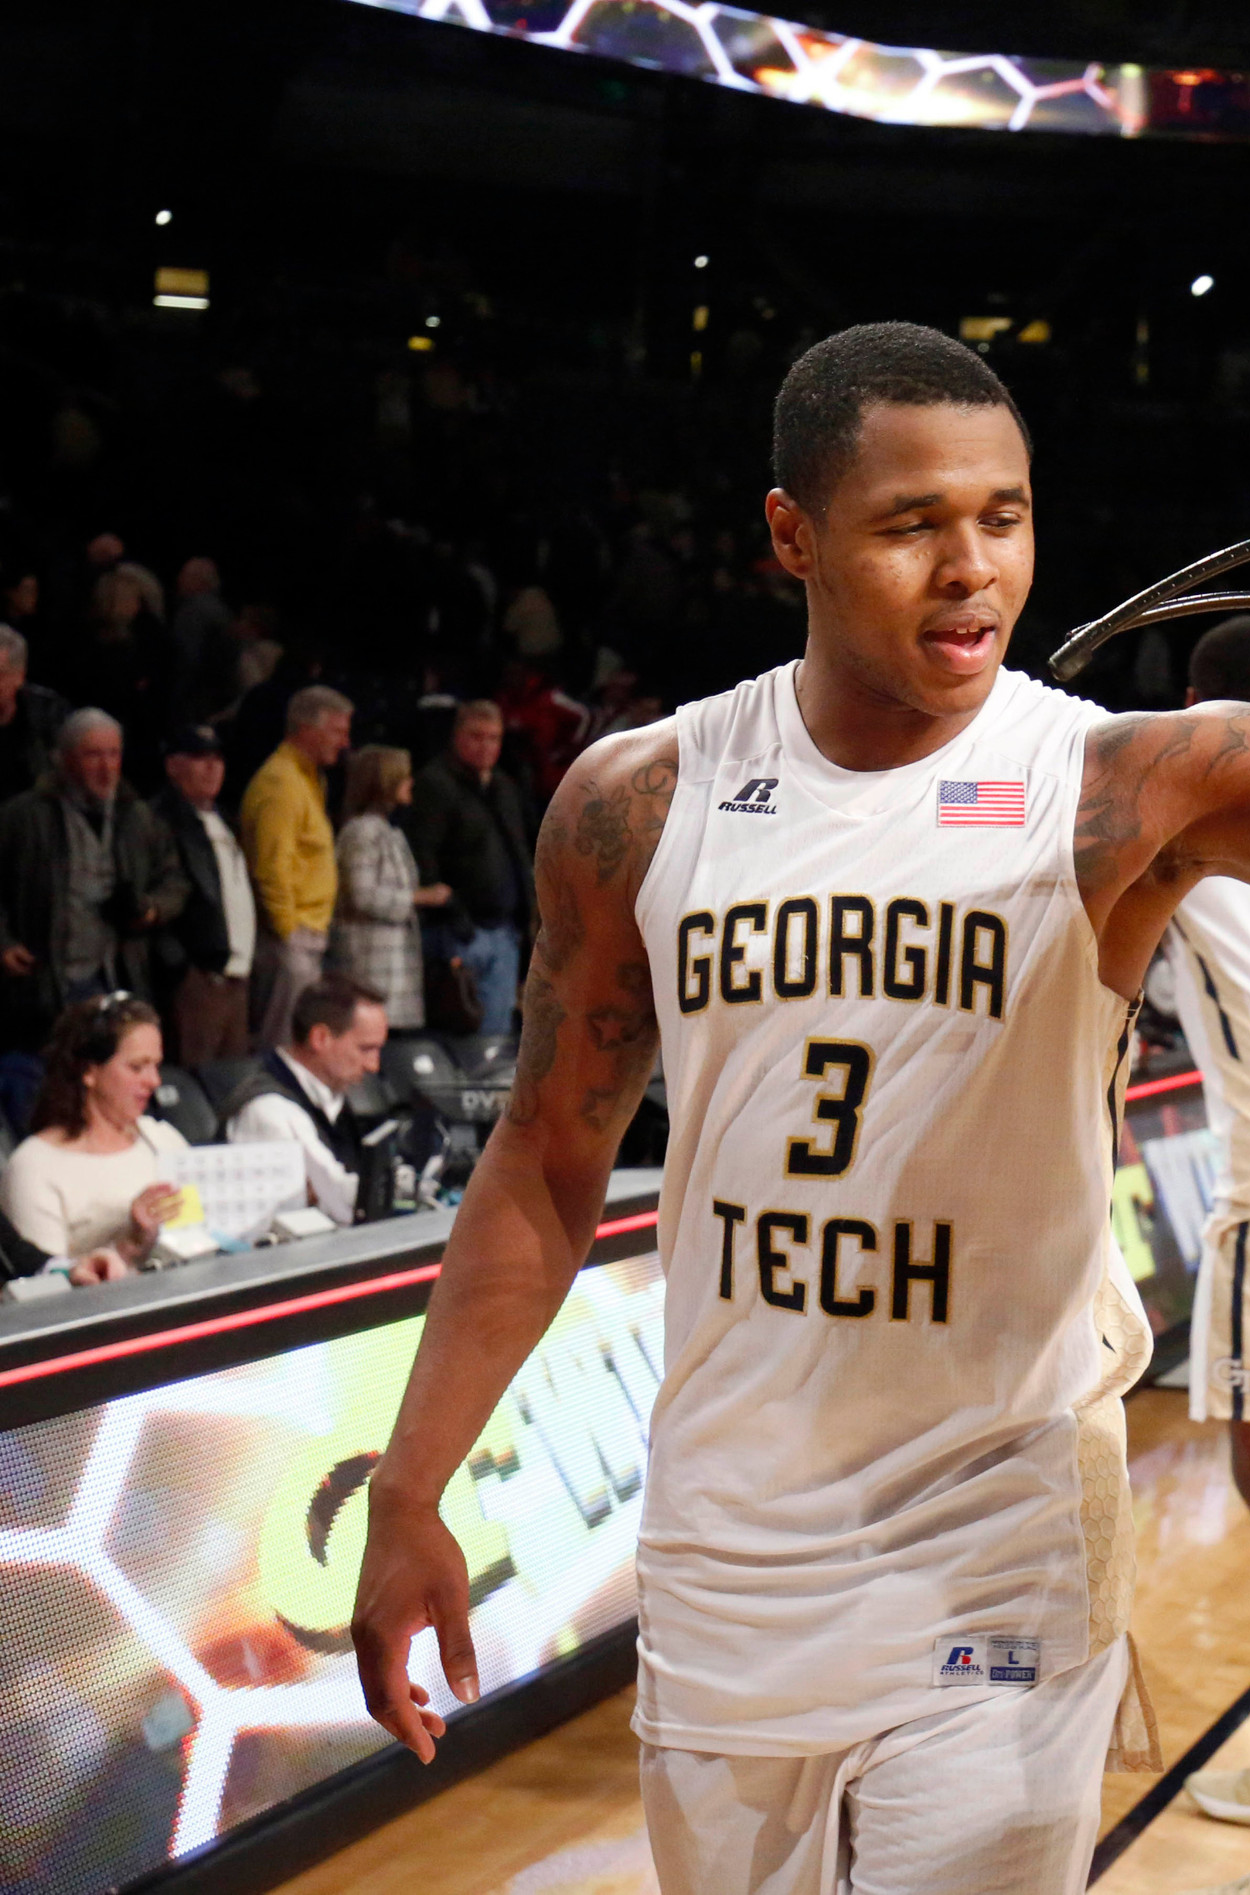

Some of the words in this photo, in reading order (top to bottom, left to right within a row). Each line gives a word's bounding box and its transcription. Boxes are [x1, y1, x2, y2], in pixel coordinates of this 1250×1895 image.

[718, 802, 777, 815] RUSSELL
[677, 891, 1010, 1020] GEORGIA
[783, 1036, 877, 1181] 3
[712, 1199, 955, 1325] TECH
[940, 1664, 981, 1672] RUSSELL
[1008, 1650, 1020, 1664] L
